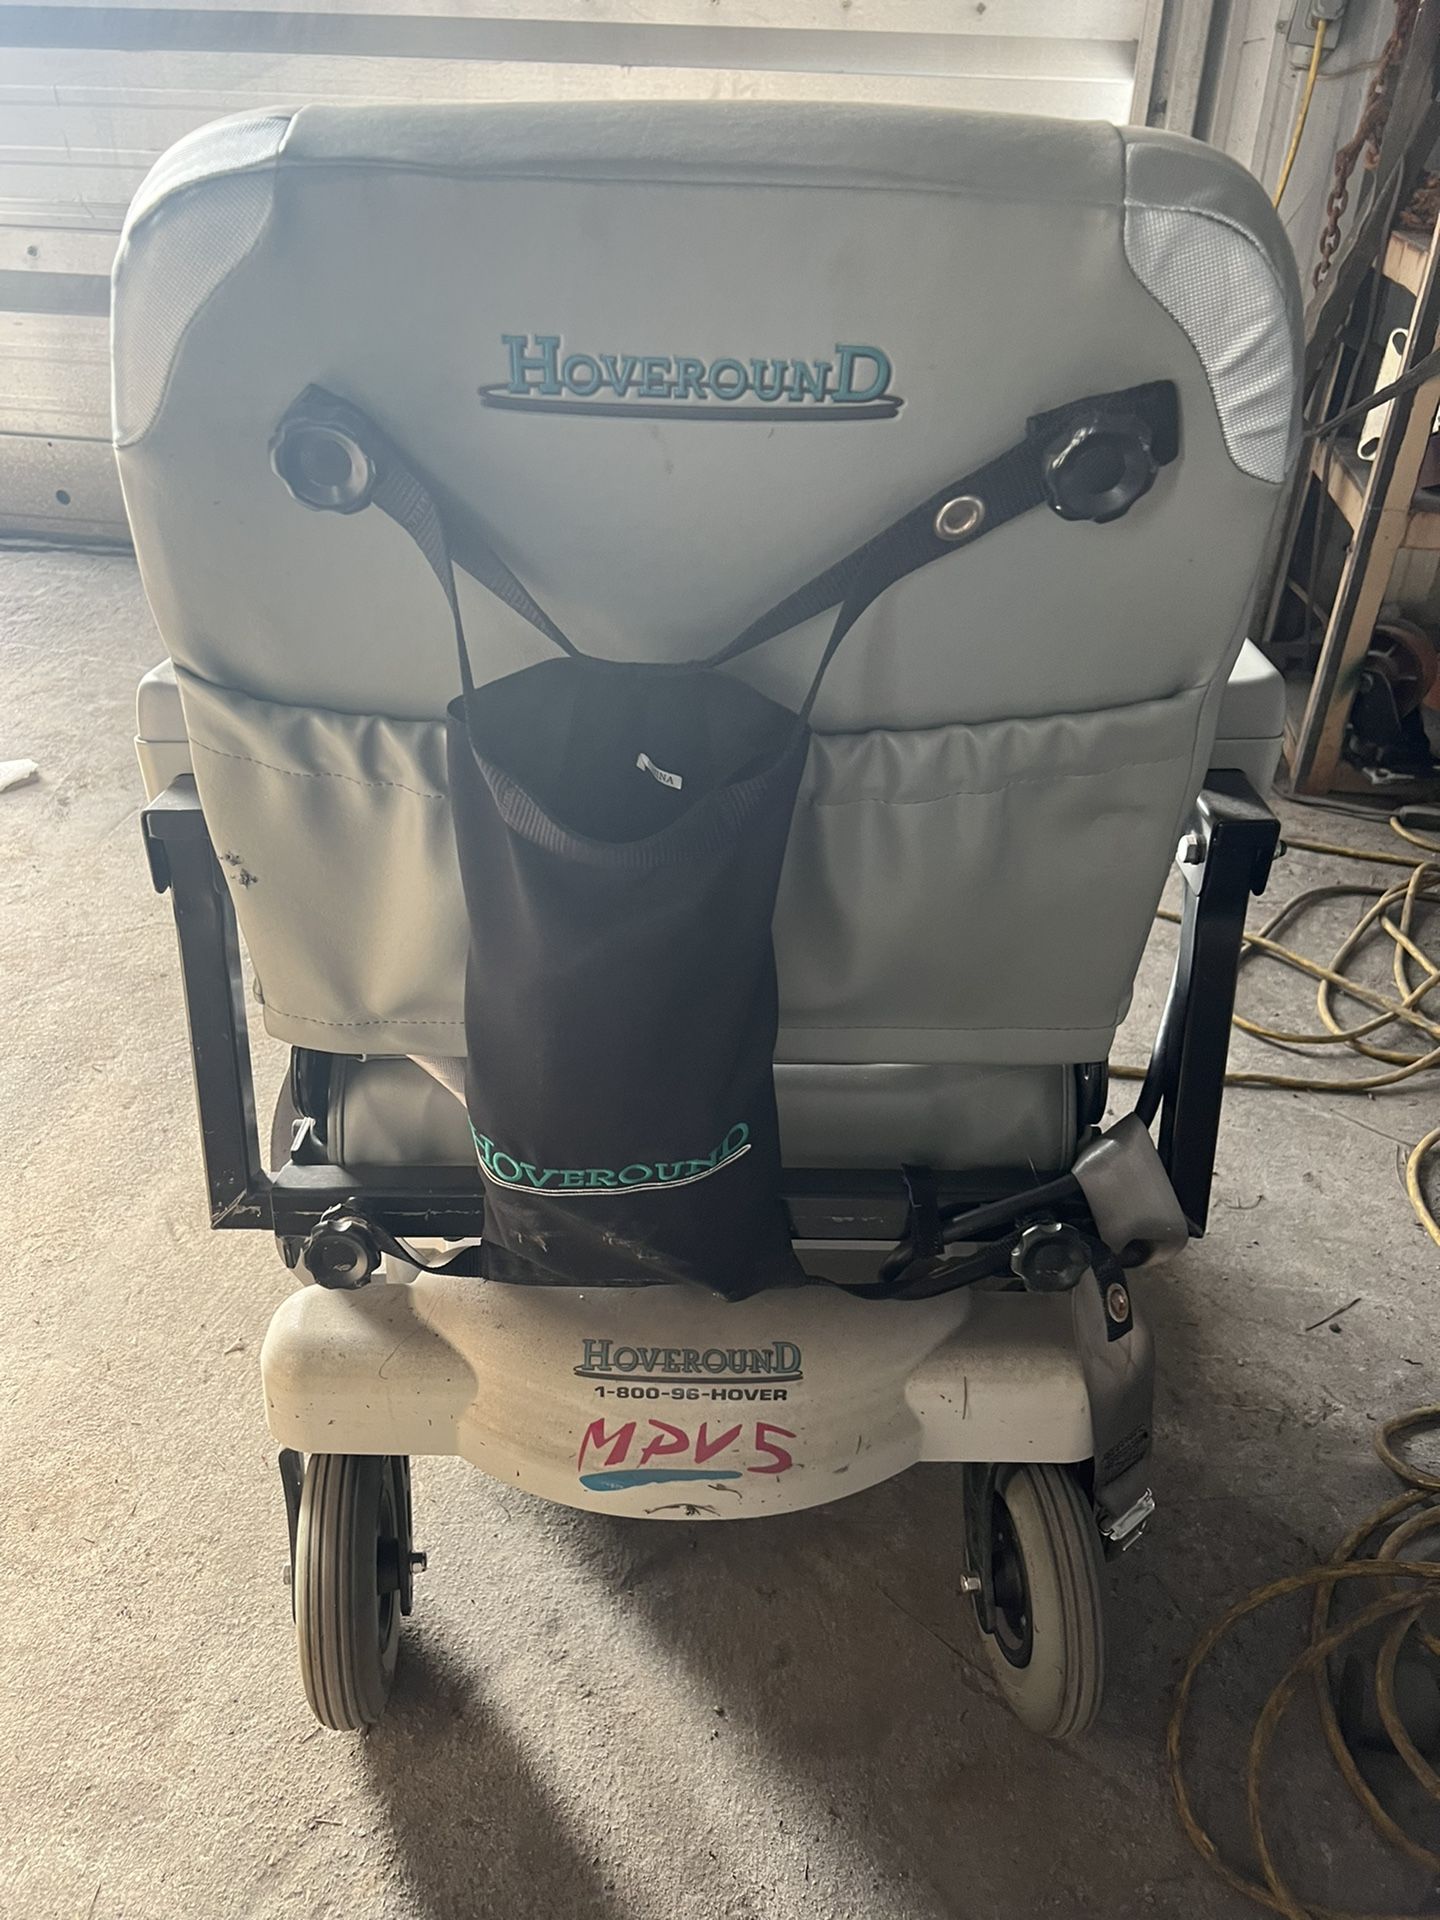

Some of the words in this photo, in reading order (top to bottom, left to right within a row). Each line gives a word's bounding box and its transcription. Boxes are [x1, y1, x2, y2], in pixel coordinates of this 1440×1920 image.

[501, 333, 893, 402] HOVEROUND
[581, 1338, 802, 1375] HOVEROUND
[594, 1385, 788, 1402] 1-800-96-HOVER
